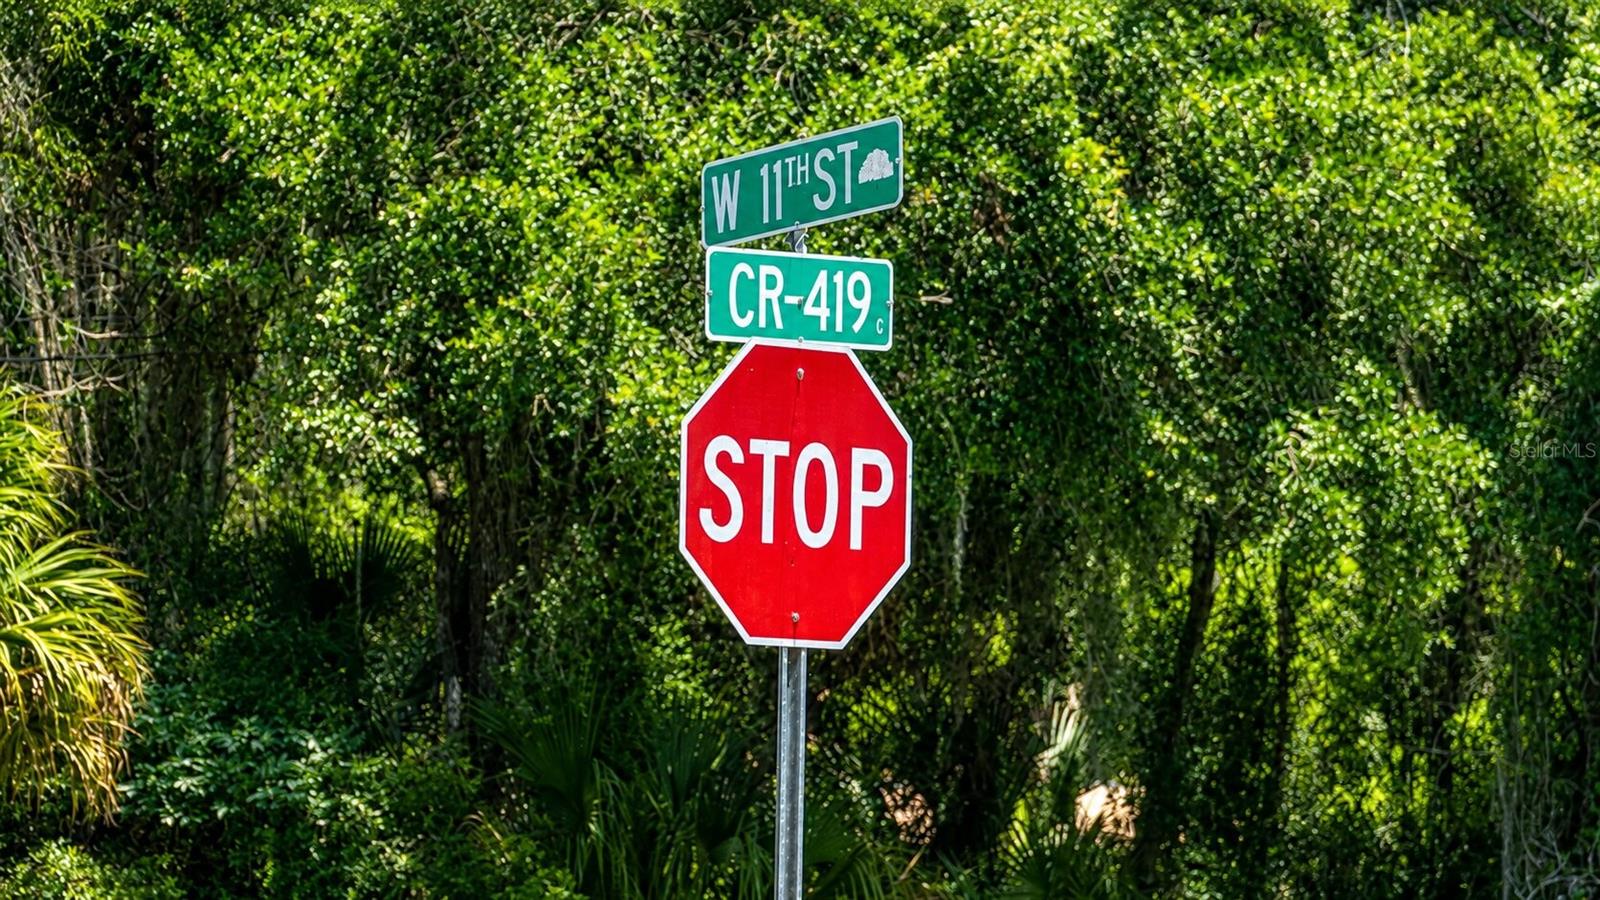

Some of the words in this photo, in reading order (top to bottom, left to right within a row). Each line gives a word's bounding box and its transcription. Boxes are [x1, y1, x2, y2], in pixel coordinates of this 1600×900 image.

[711, 169, 741, 234] W
[760, 152, 809, 224] 11TH
[813, 141, 858, 211] ST
[729, 262, 872, 334] CR-419
[700, 434, 895, 551] STOP
